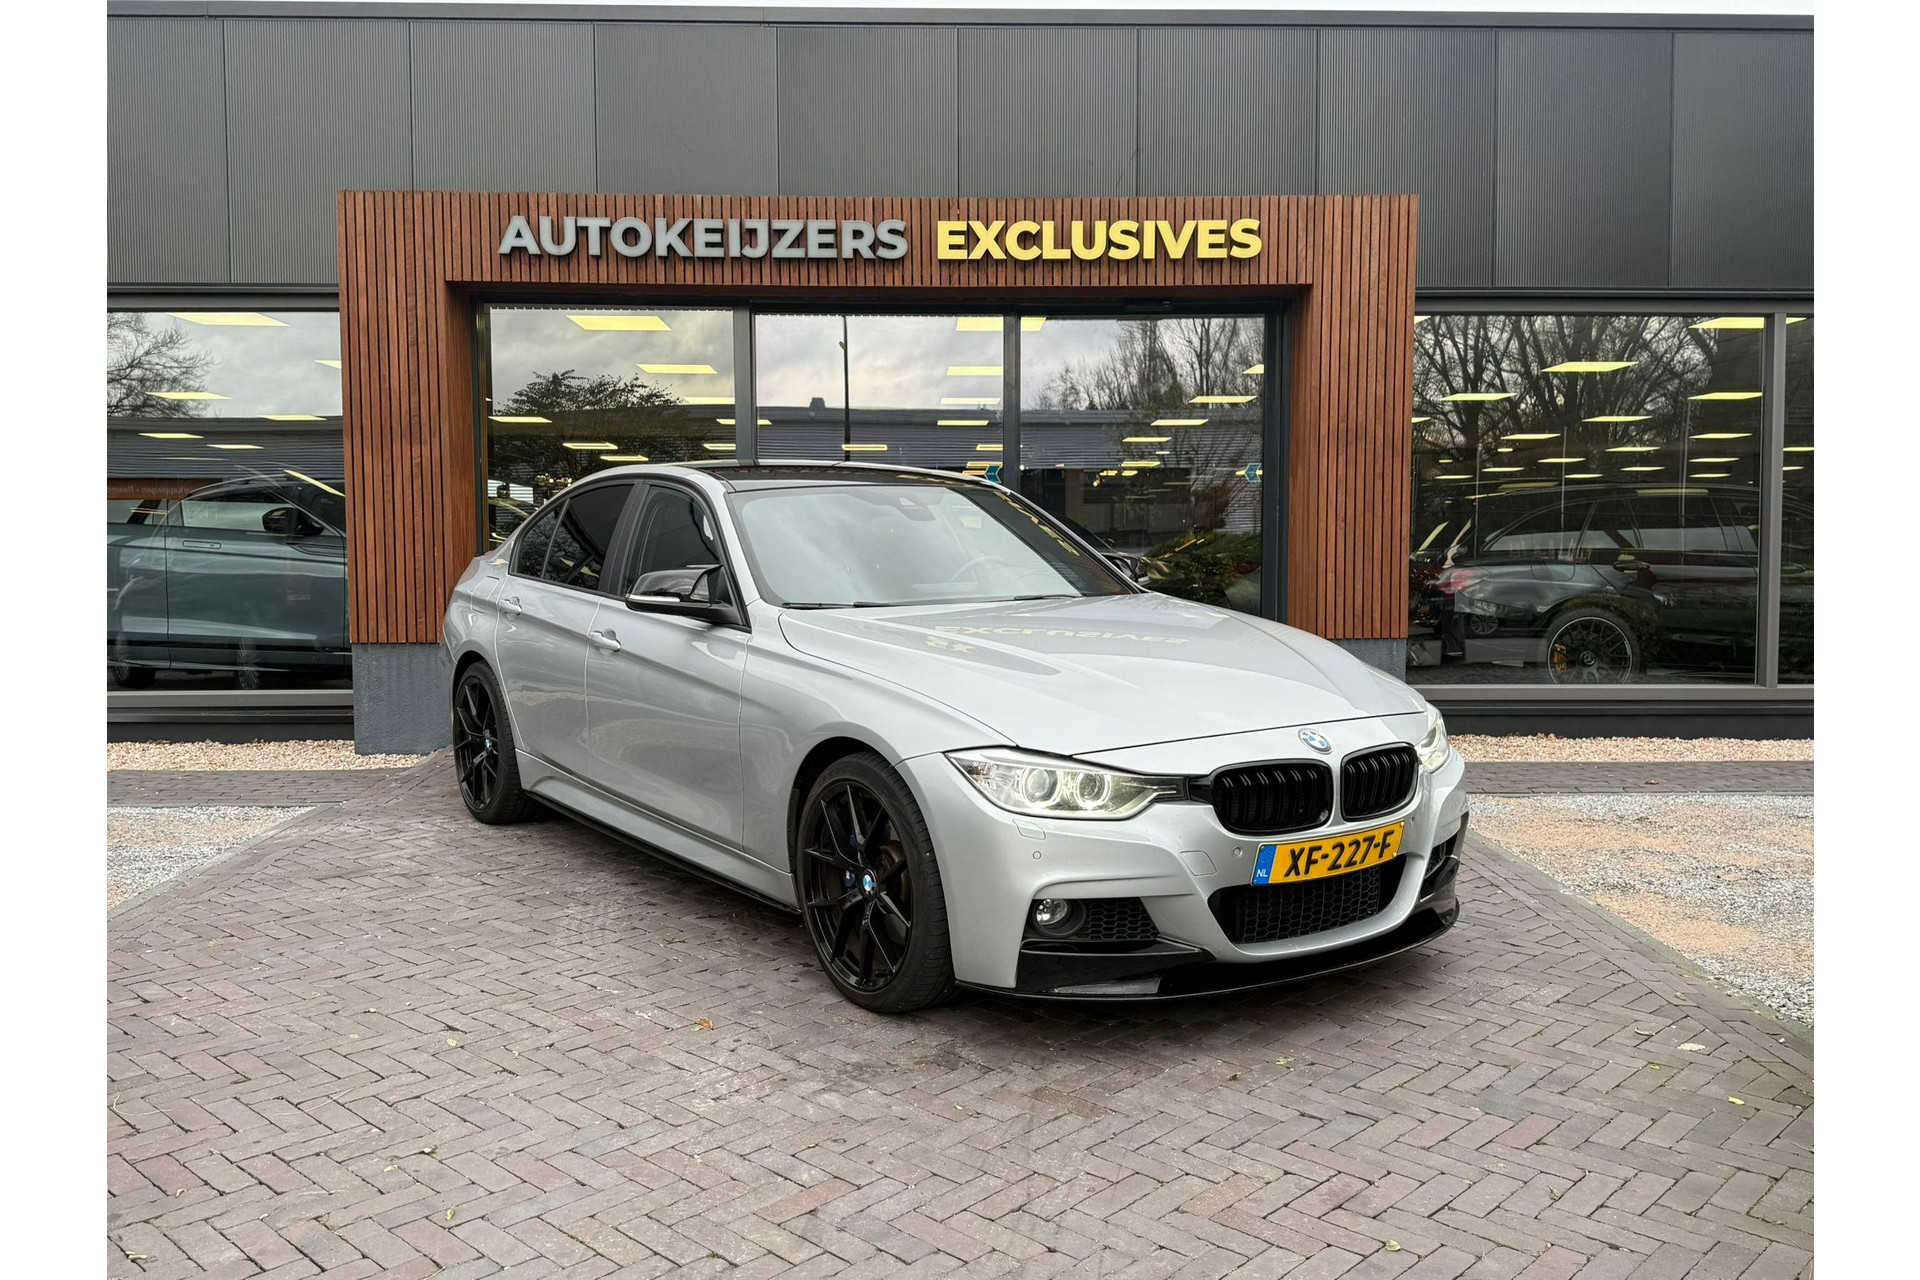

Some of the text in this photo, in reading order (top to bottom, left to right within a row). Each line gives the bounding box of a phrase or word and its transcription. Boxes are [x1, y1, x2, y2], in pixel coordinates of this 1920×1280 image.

[498, 215, 1263, 261] AUTOKEIJZERS EXCLUSIVES
[1256, 868, 1268, 878] NL
[1284, 829, 1395, 878] XF-227-F
